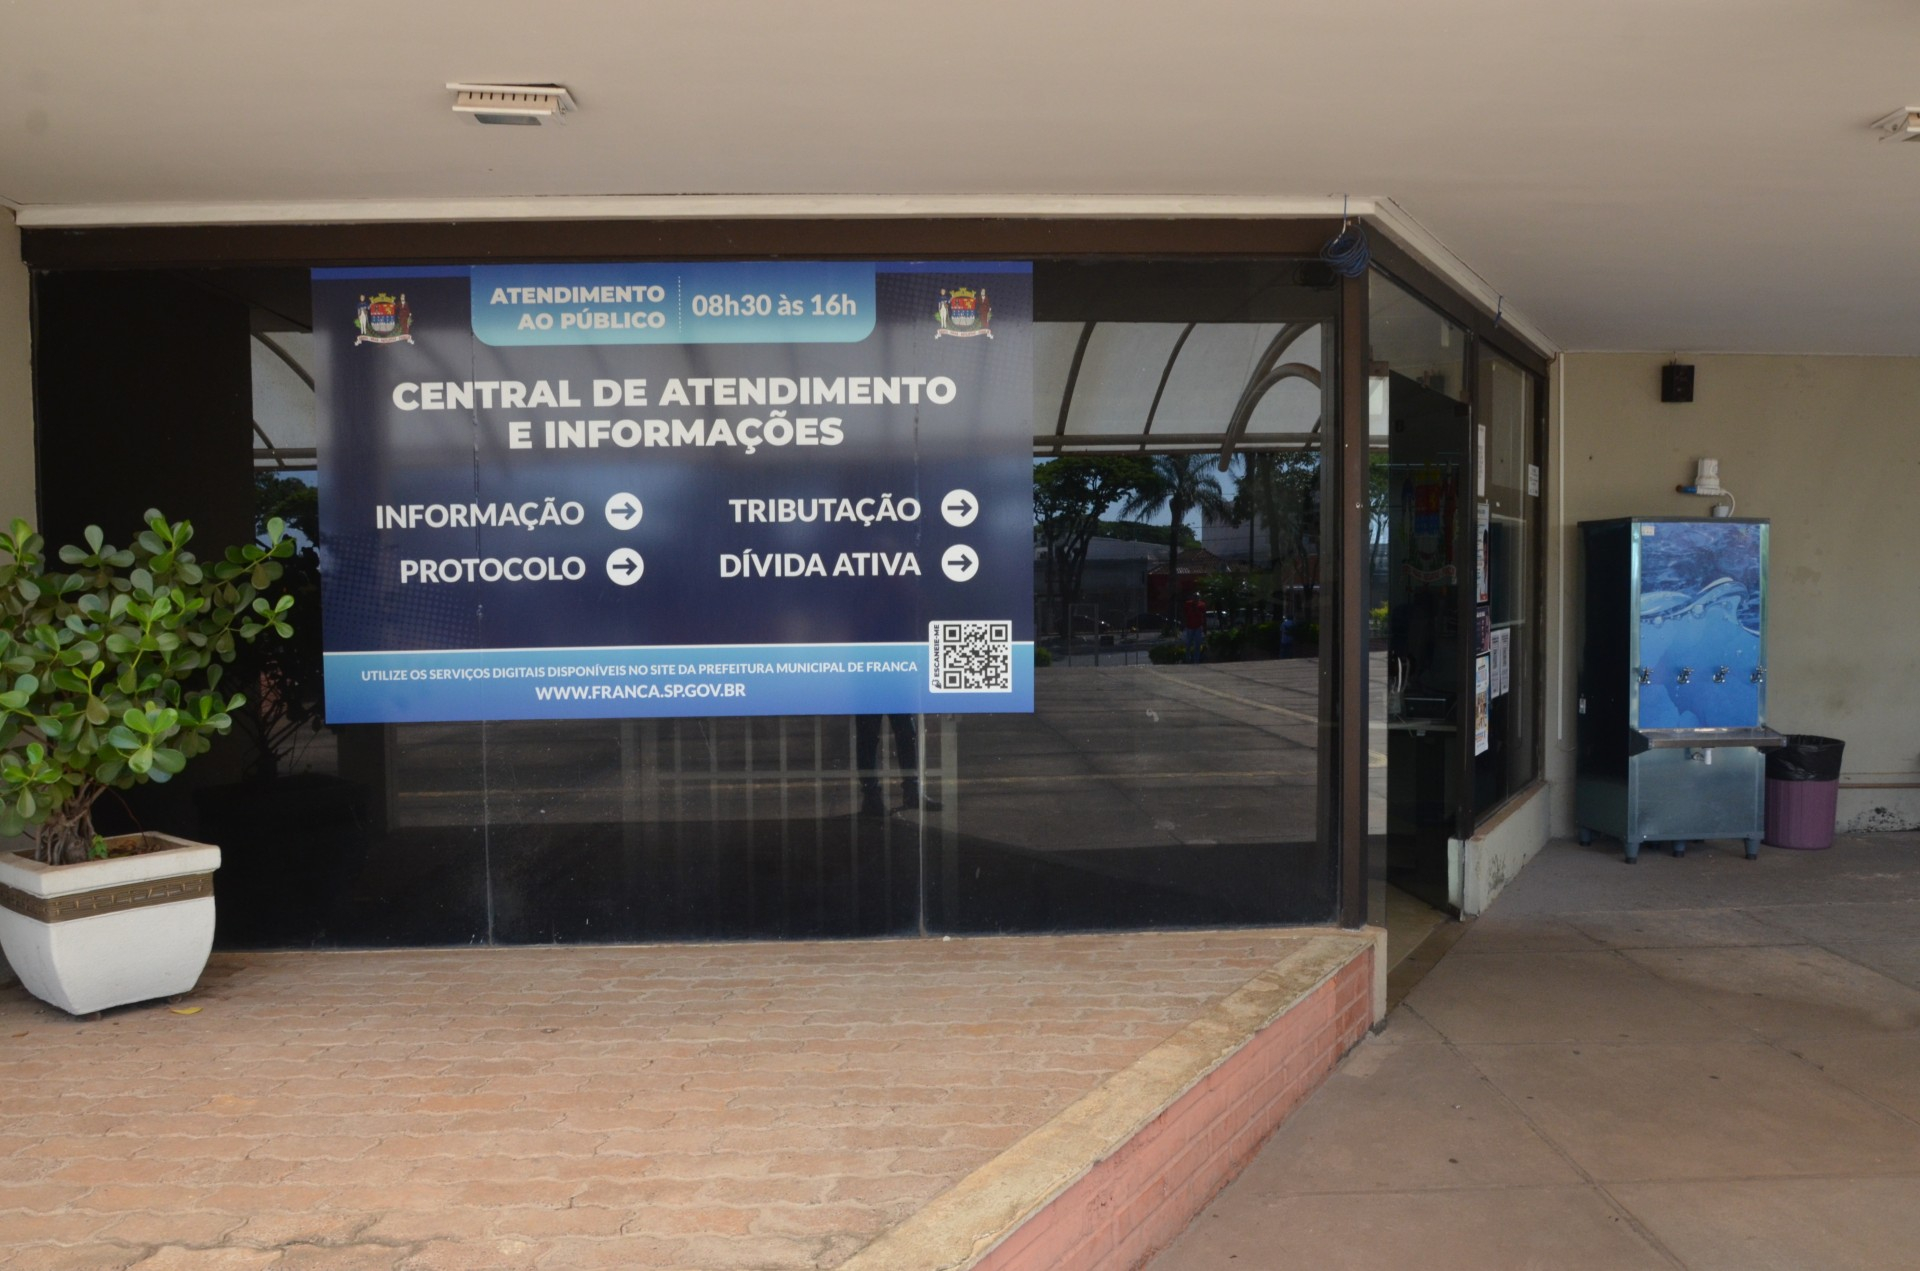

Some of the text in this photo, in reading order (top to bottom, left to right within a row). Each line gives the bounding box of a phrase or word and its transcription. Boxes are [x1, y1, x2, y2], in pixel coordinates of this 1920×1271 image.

[489, 285, 666, 305] ATENDIMENTO
[691, 293, 857, 317] 08h30 às 16h
[517, 308, 666, 331] AO PÚBLICO
[392, 376, 957, 410] CENTRAL DE ATENDIMENTO
[508, 410, 844, 454] E INFORMAÇÕES
[376, 497, 585, 531] INFORMAÇÃO
[728, 493, 921, 527] TRIBUTAÇÃO
[400, 556, 586, 584] PROTOCOLO
[720, 549, 922, 578] DÍVIDA ATIVA
[361, 661, 918, 682] UTILIZE OS SERVIÇOS DIGITAIS DISPONÍVEIS NO SITE DA PREFEITURA MUNICIPAL DE FRANCA
[535, 683, 746, 701] WWW.FRANCA.SP.GOV.BR
